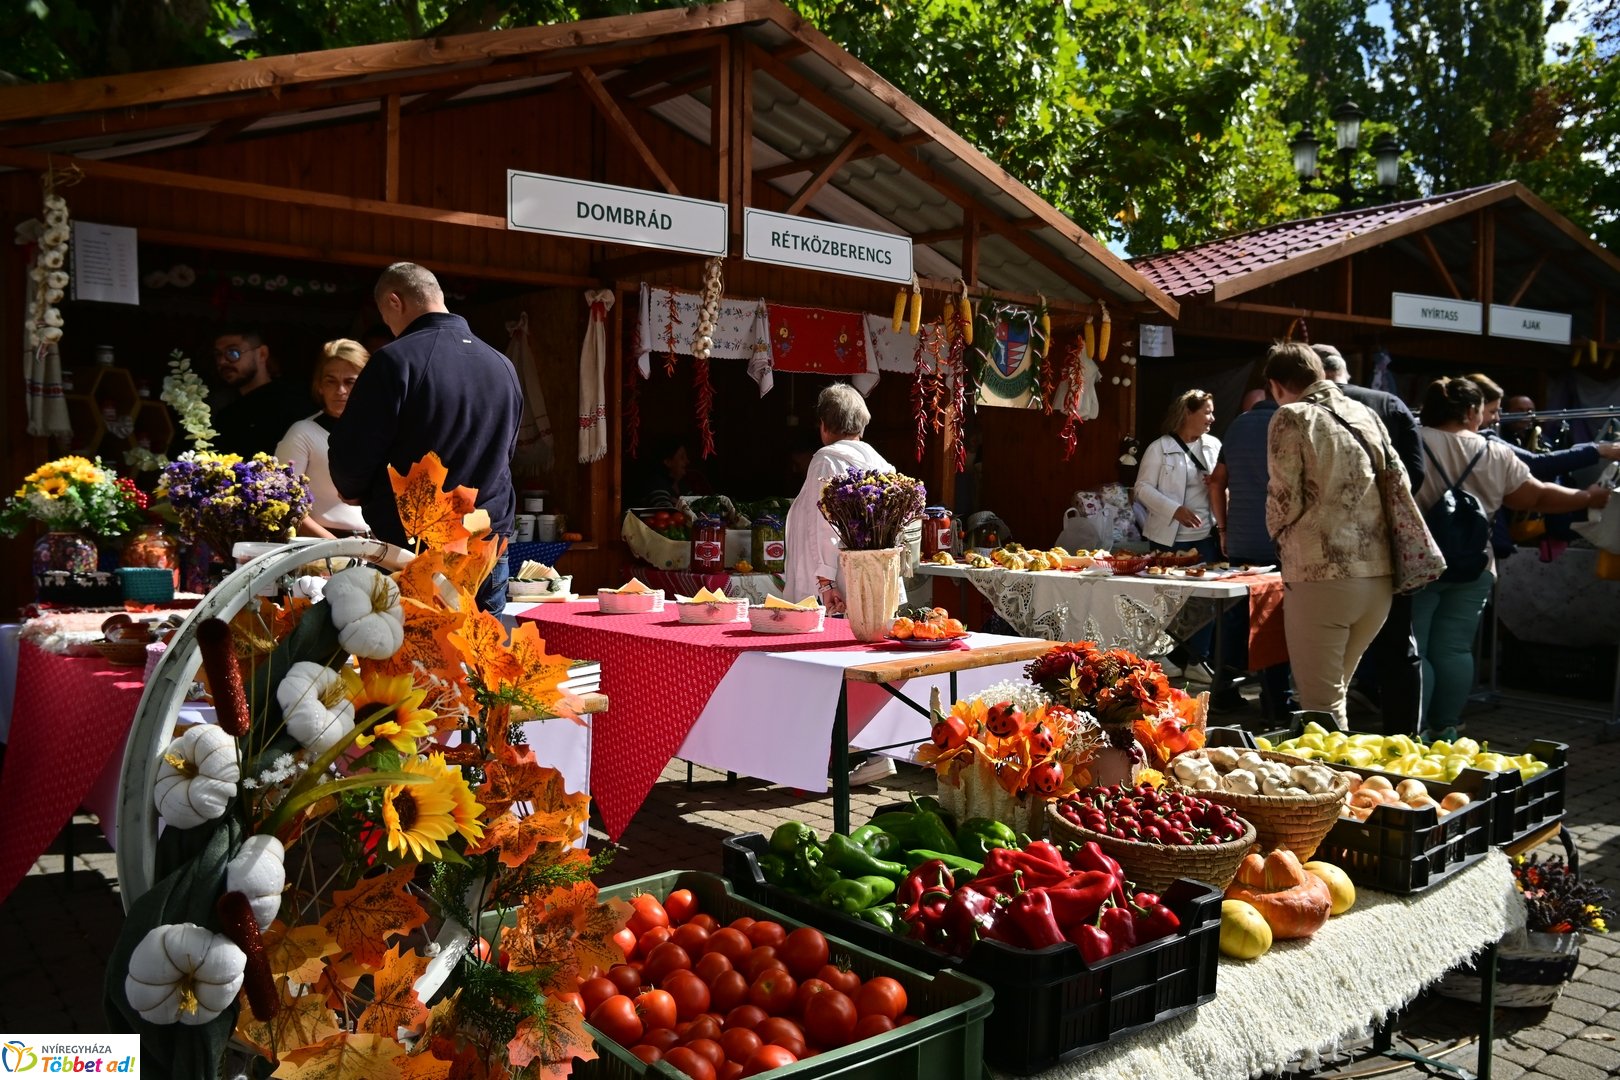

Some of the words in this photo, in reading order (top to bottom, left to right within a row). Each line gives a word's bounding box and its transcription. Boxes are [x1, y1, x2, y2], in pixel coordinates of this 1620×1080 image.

[576, 200, 672, 231] DOMBRÁD
[771, 230, 892, 266] RÉTKÖZBERENCS
[1421, 307, 1459, 322] NYÍRTASS
[1522, 319, 1541, 330] AJAK
